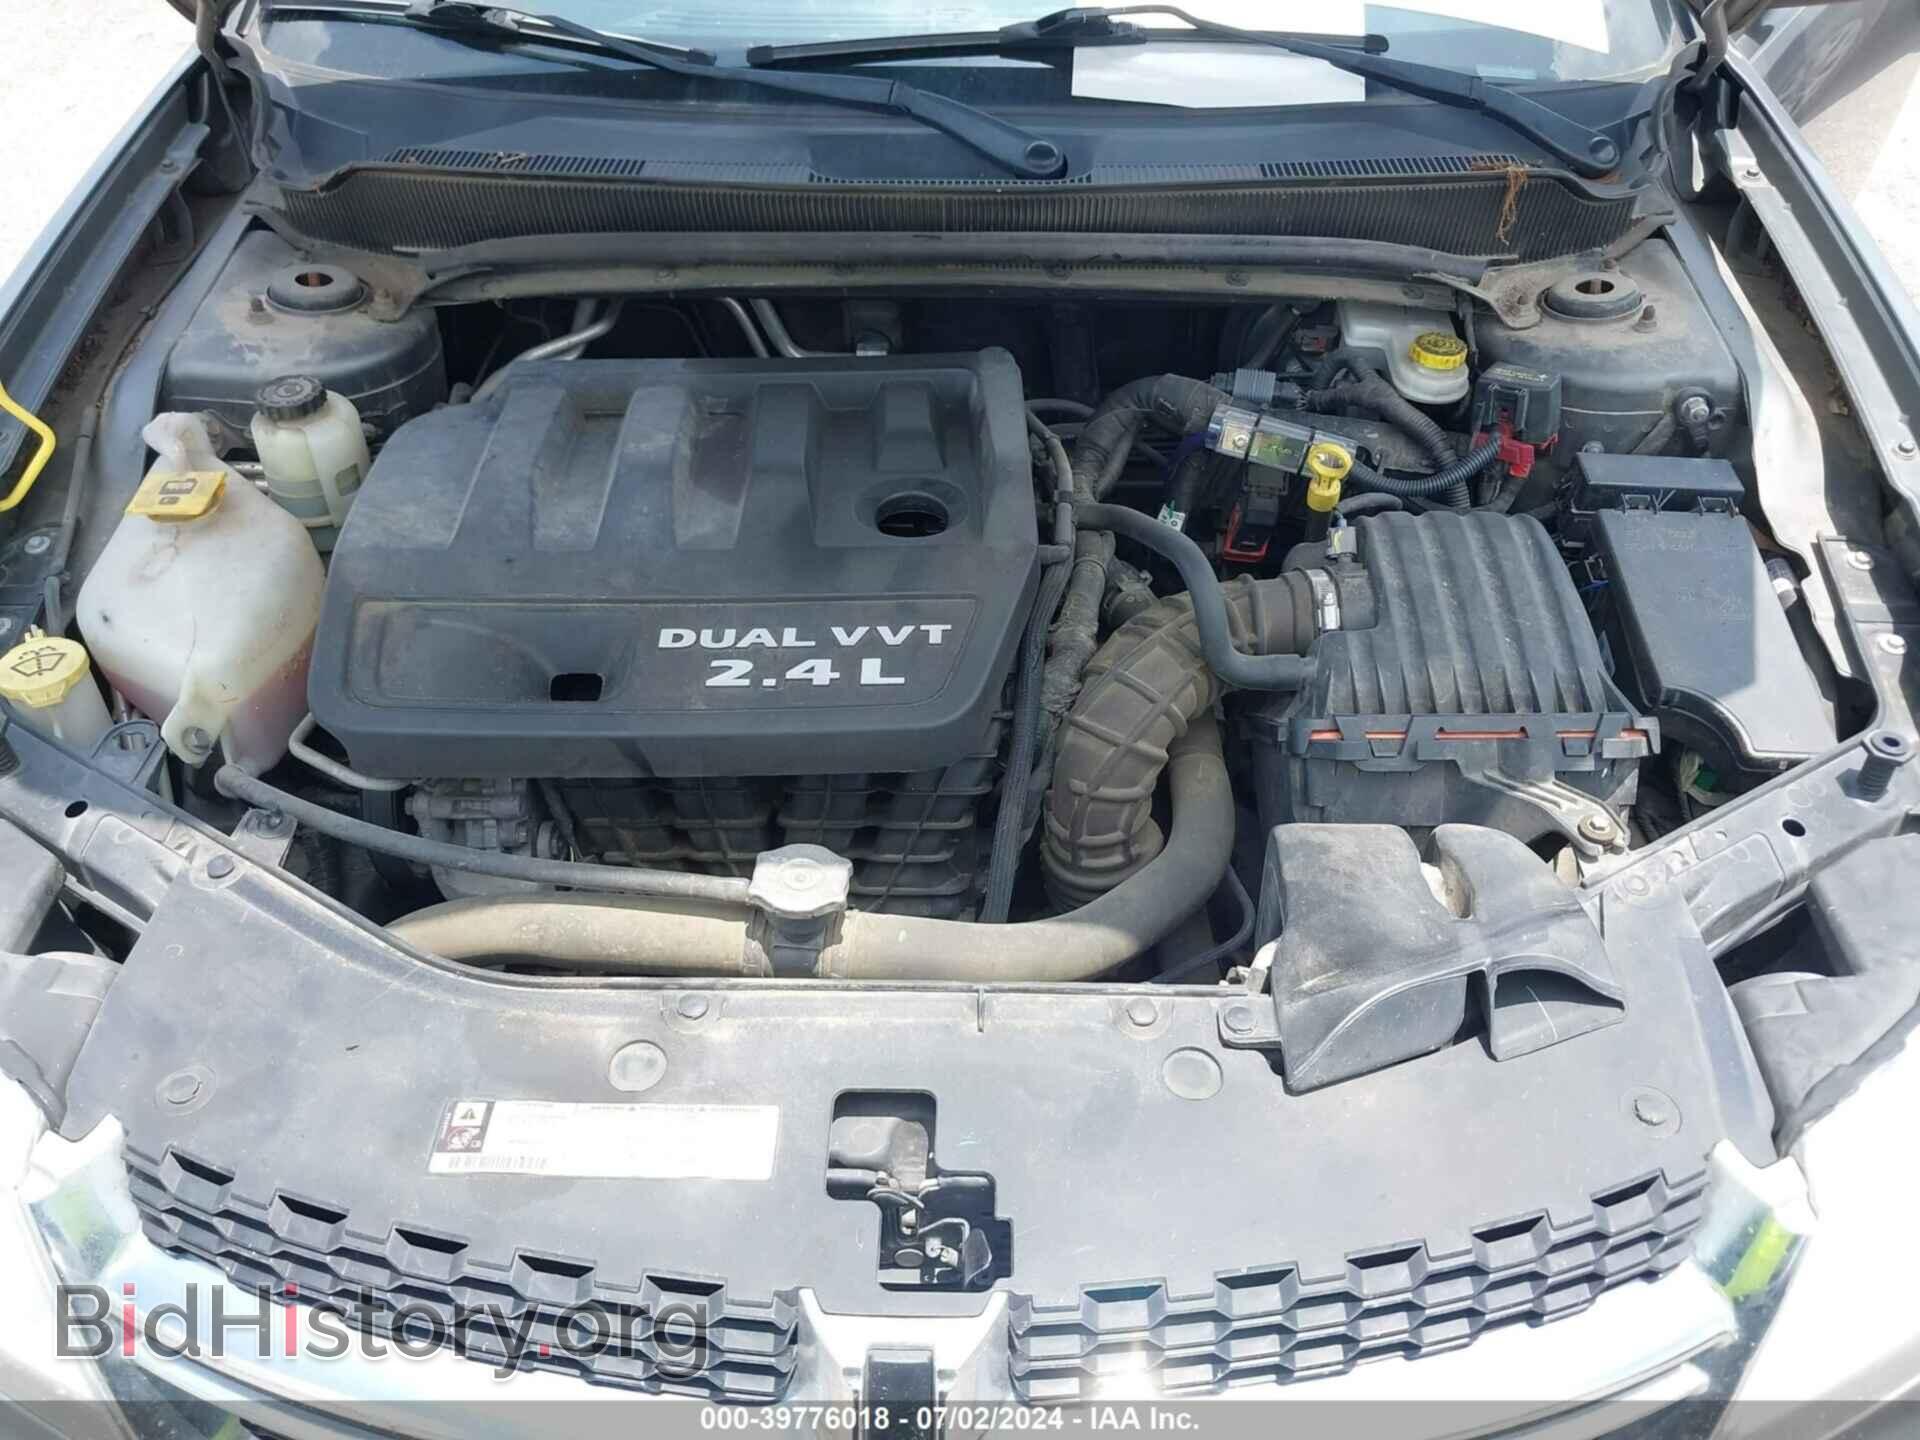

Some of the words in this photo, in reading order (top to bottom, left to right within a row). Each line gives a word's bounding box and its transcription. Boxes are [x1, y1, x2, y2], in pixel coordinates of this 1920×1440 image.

[658, 627, 816, 648] DUAL
[830, 624, 952, 646] VVT
[705, 658, 840, 686] 2.4
[860, 657, 905, 684] L
